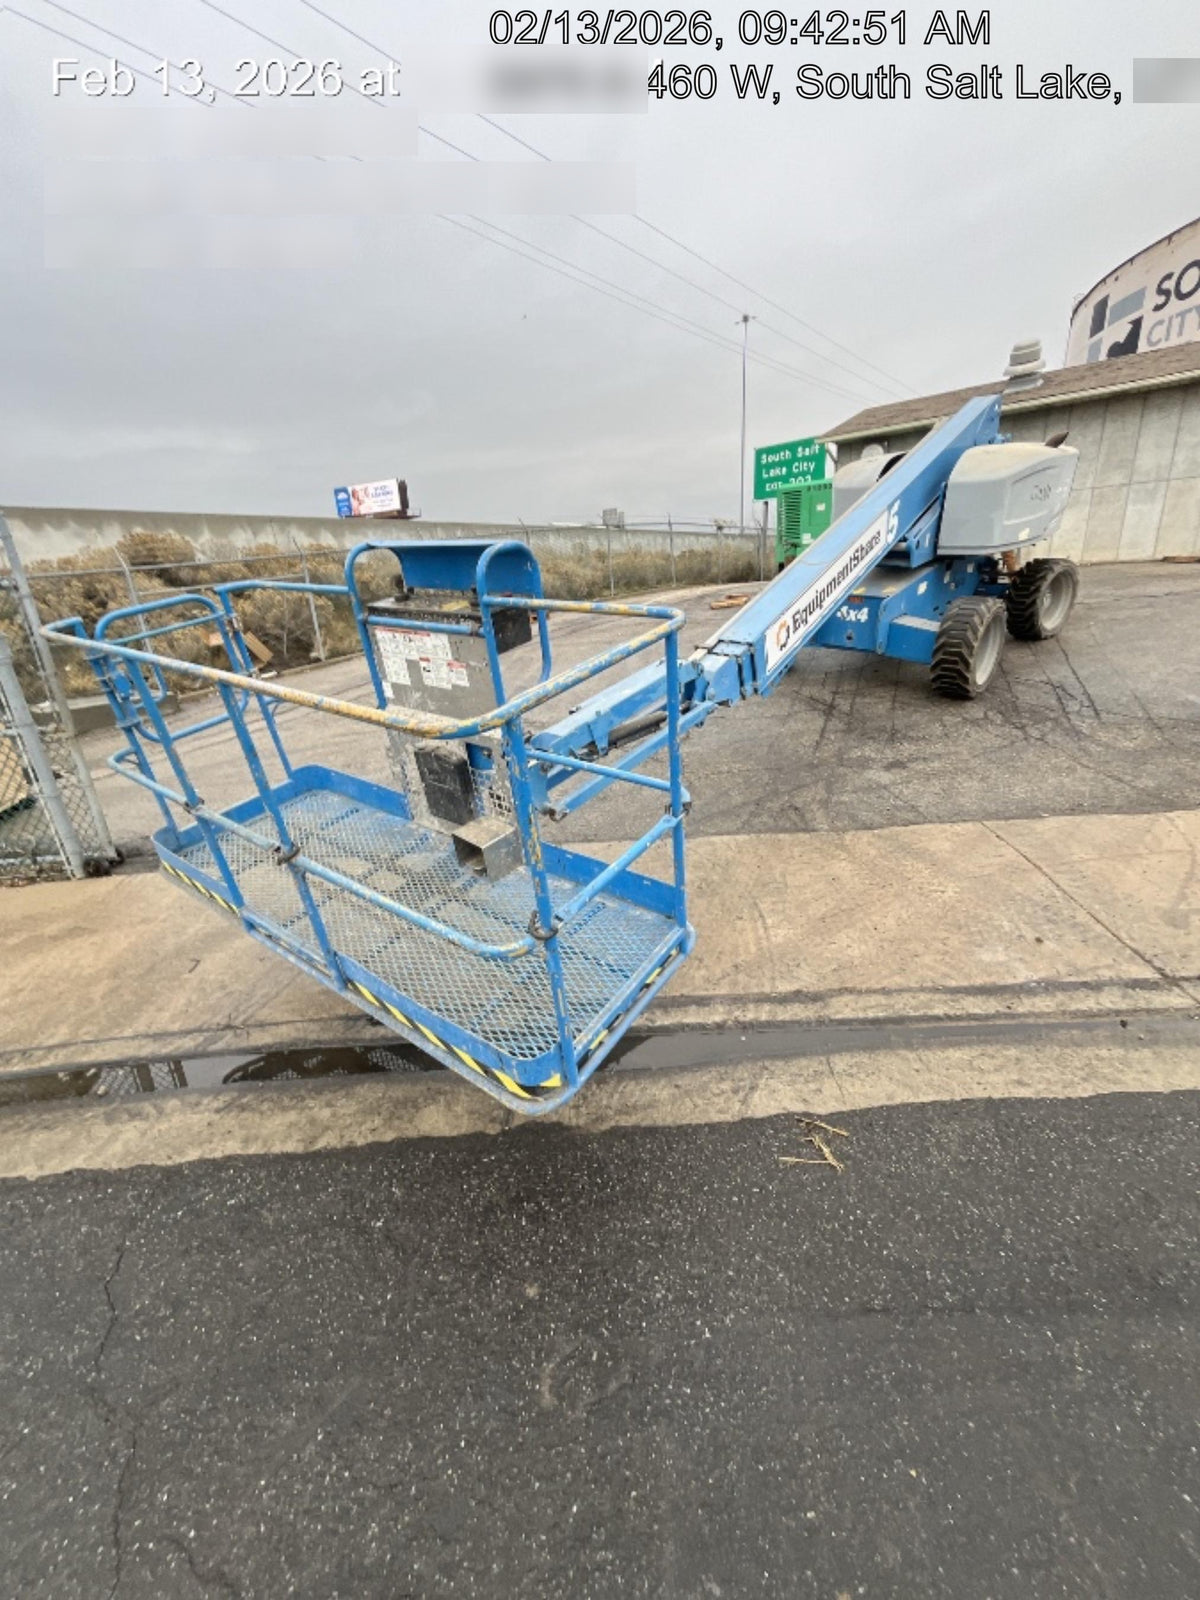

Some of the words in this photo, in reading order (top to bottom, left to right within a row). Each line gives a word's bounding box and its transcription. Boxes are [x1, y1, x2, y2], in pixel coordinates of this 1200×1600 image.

[760, 449, 792, 464] South
[797, 444, 820, 457] Salt
[762, 466, 787, 478] Lake
[792, 461, 815, 473] City
[792, 530, 881, 633] EquipmentShare
